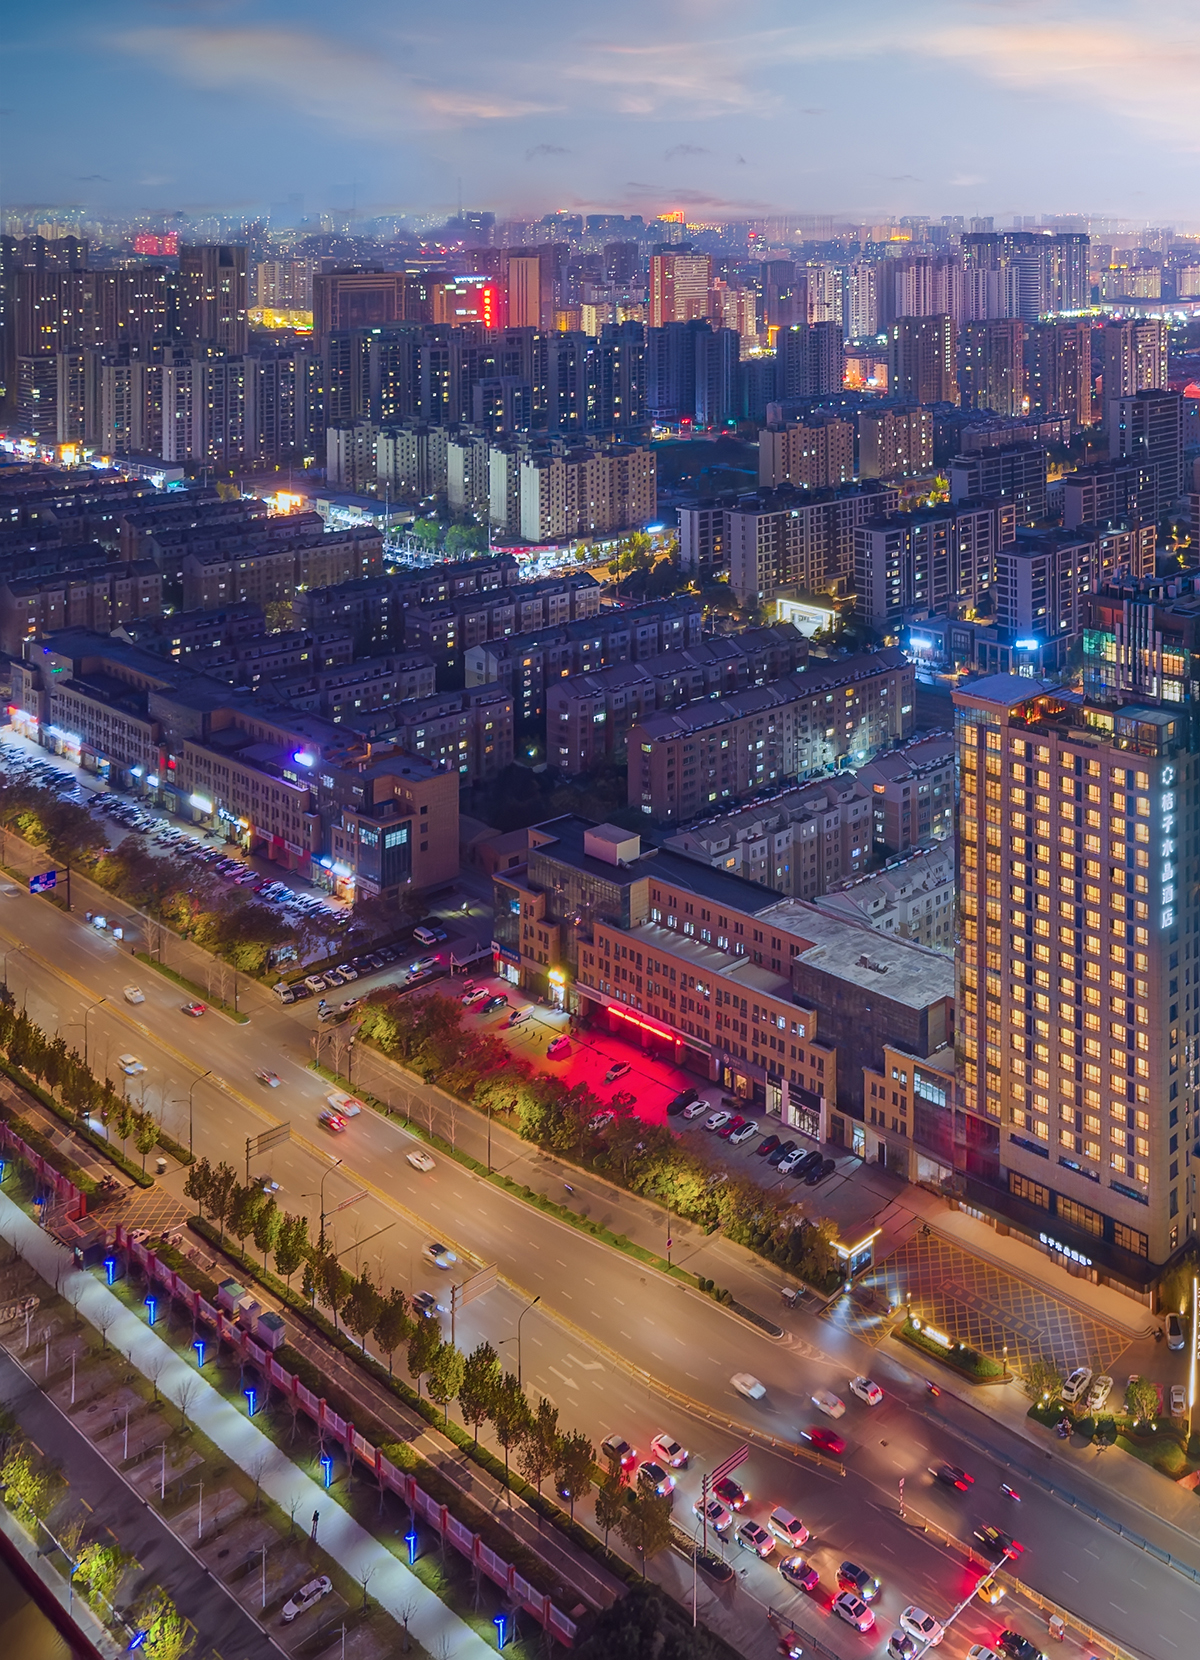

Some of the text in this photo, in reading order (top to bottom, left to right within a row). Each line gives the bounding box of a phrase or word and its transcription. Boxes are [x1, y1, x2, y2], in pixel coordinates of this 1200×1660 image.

[1161, 793, 1174, 929] 桔子水晶酒店
